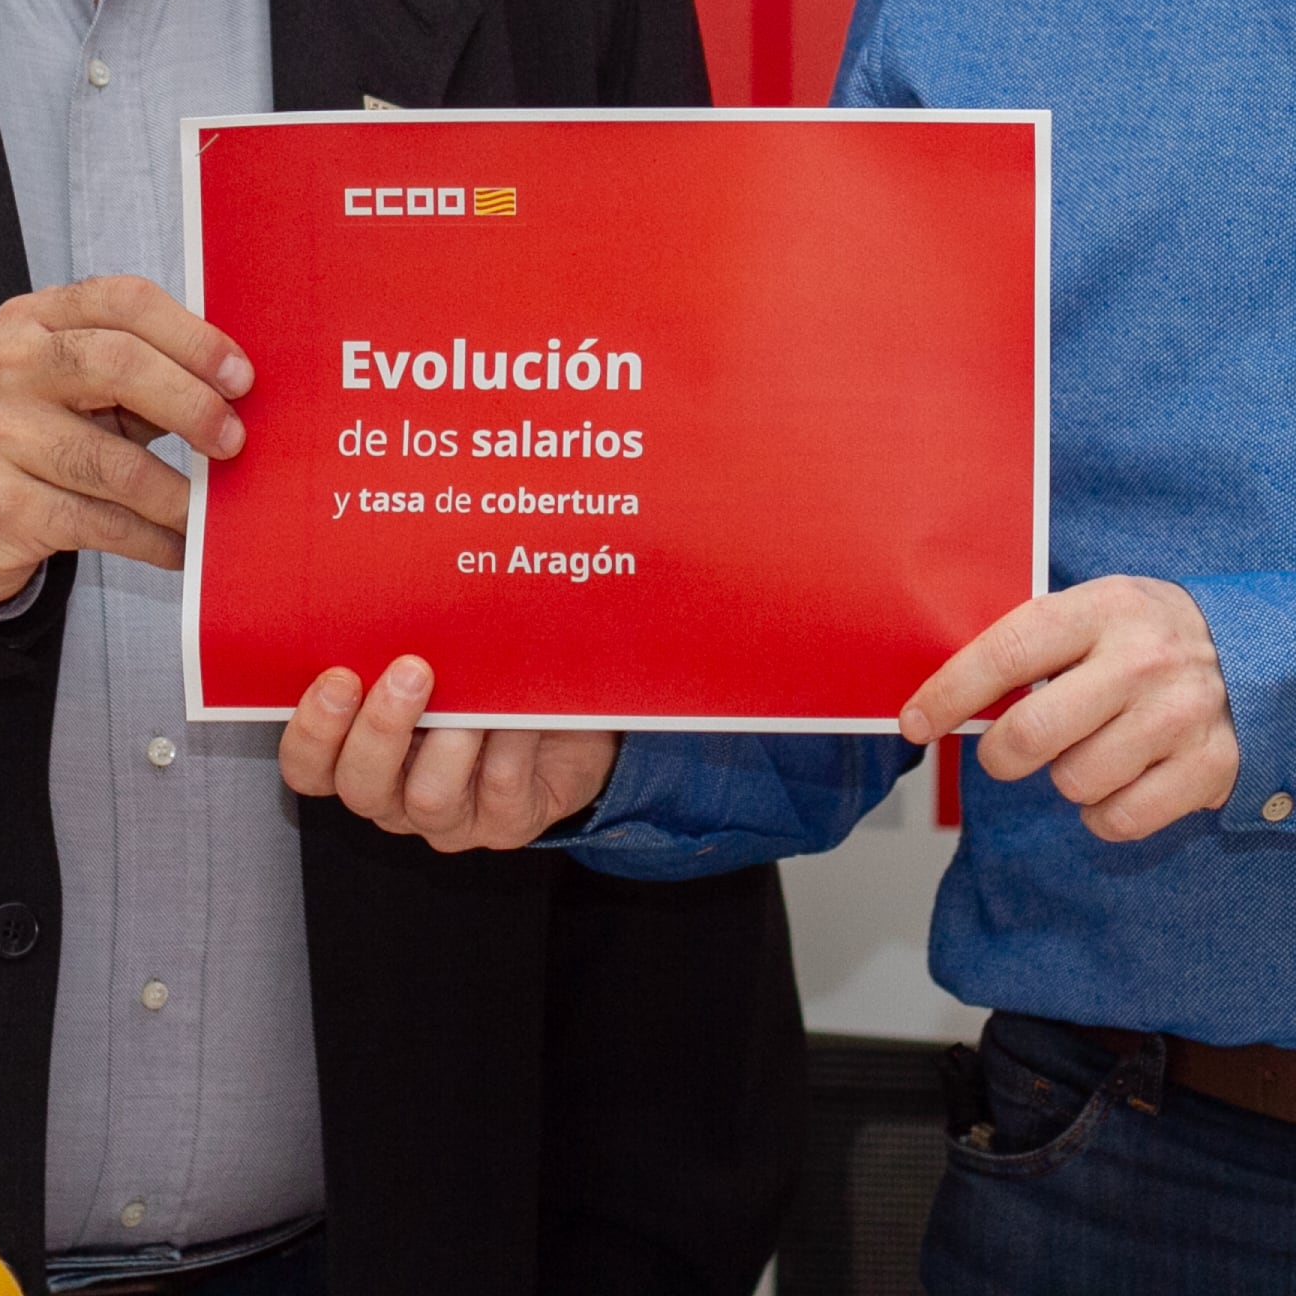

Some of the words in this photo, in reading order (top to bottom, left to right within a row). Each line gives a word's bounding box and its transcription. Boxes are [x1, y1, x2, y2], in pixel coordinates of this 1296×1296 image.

[344, 187, 465, 216] CCOO
[341, 337, 644, 392] Evolución
[337, 419, 388, 458] de
[402, 419, 459, 458] los
[471, 419, 644, 459] salarios
[332, 492, 351, 520] y
[358, 488, 426, 514] tasa
[434, 485, 473, 515] de
[480, 486, 640, 516] cobertura
[456, 551, 497, 575] en
[506, 544, 636, 584] Aragón
